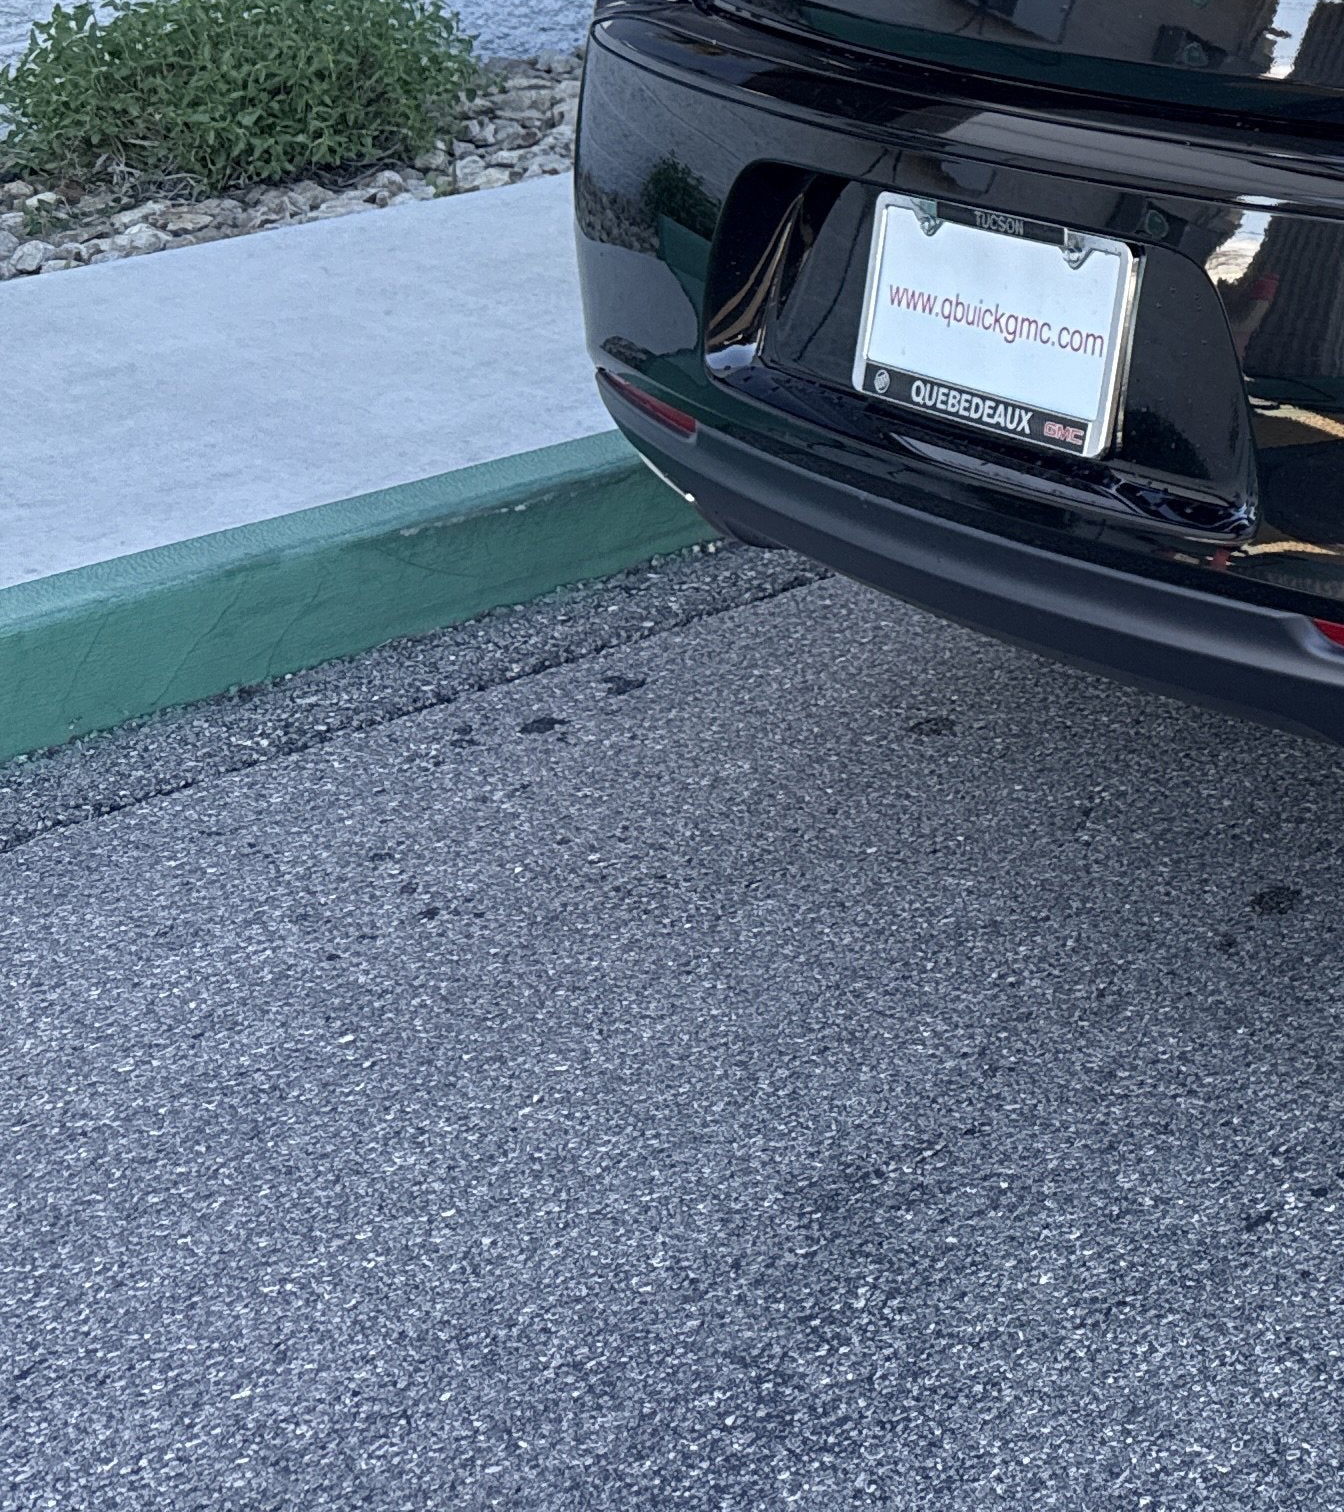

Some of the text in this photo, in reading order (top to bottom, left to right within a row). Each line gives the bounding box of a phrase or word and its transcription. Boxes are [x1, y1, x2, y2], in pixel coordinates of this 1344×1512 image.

[974, 210, 1024, 236] TUCSON
[889, 284, 1105, 357] www.qbuickgmc.com
[911, 379, 1033, 435] QUEBEDEAUX
[1043, 420, 1085, 445] GMC
